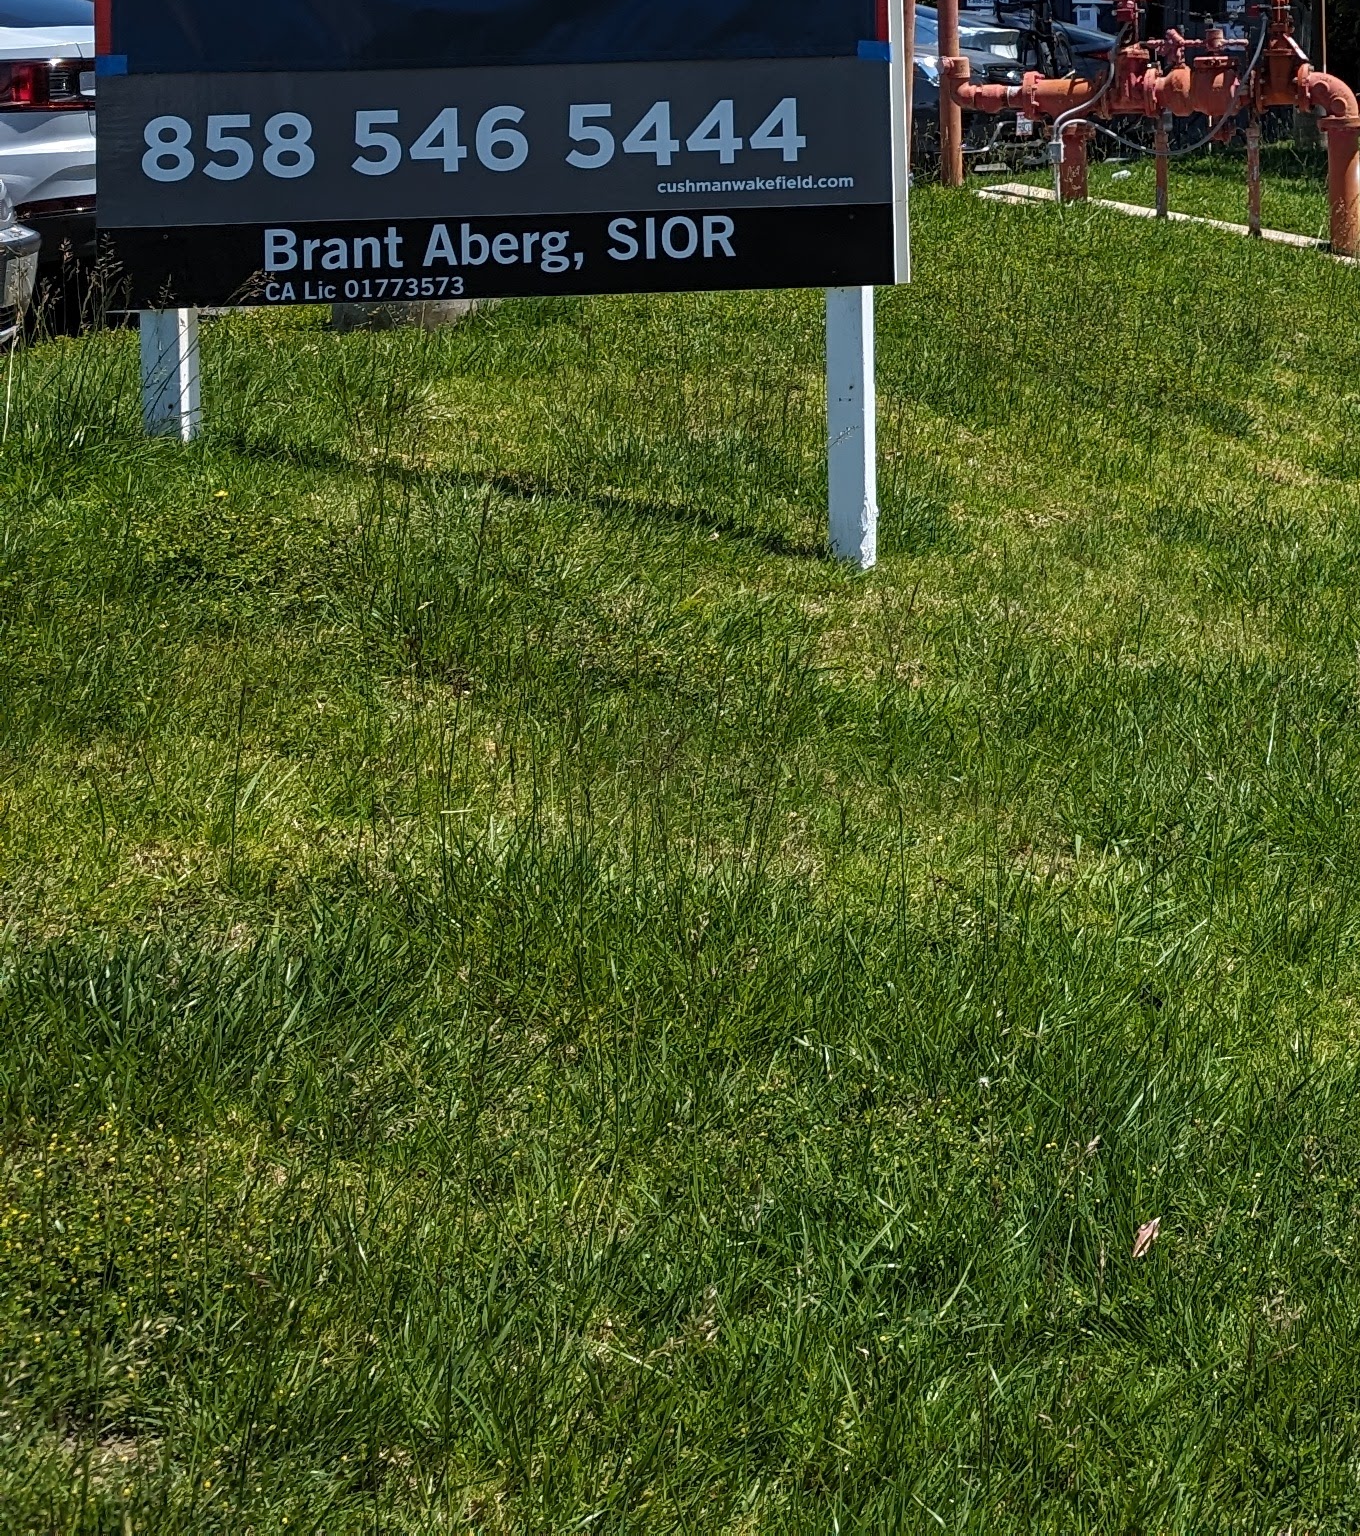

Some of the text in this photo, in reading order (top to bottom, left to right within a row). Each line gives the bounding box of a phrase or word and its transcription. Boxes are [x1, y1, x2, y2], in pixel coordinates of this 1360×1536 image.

[141, 97, 807, 183] 858 546 5444
[657, 175, 855, 194] cushmanwakefield.com
[264, 215, 736, 273] Brant Aberg, SIOR
[265, 275, 465, 302] CA Lic 01773573
